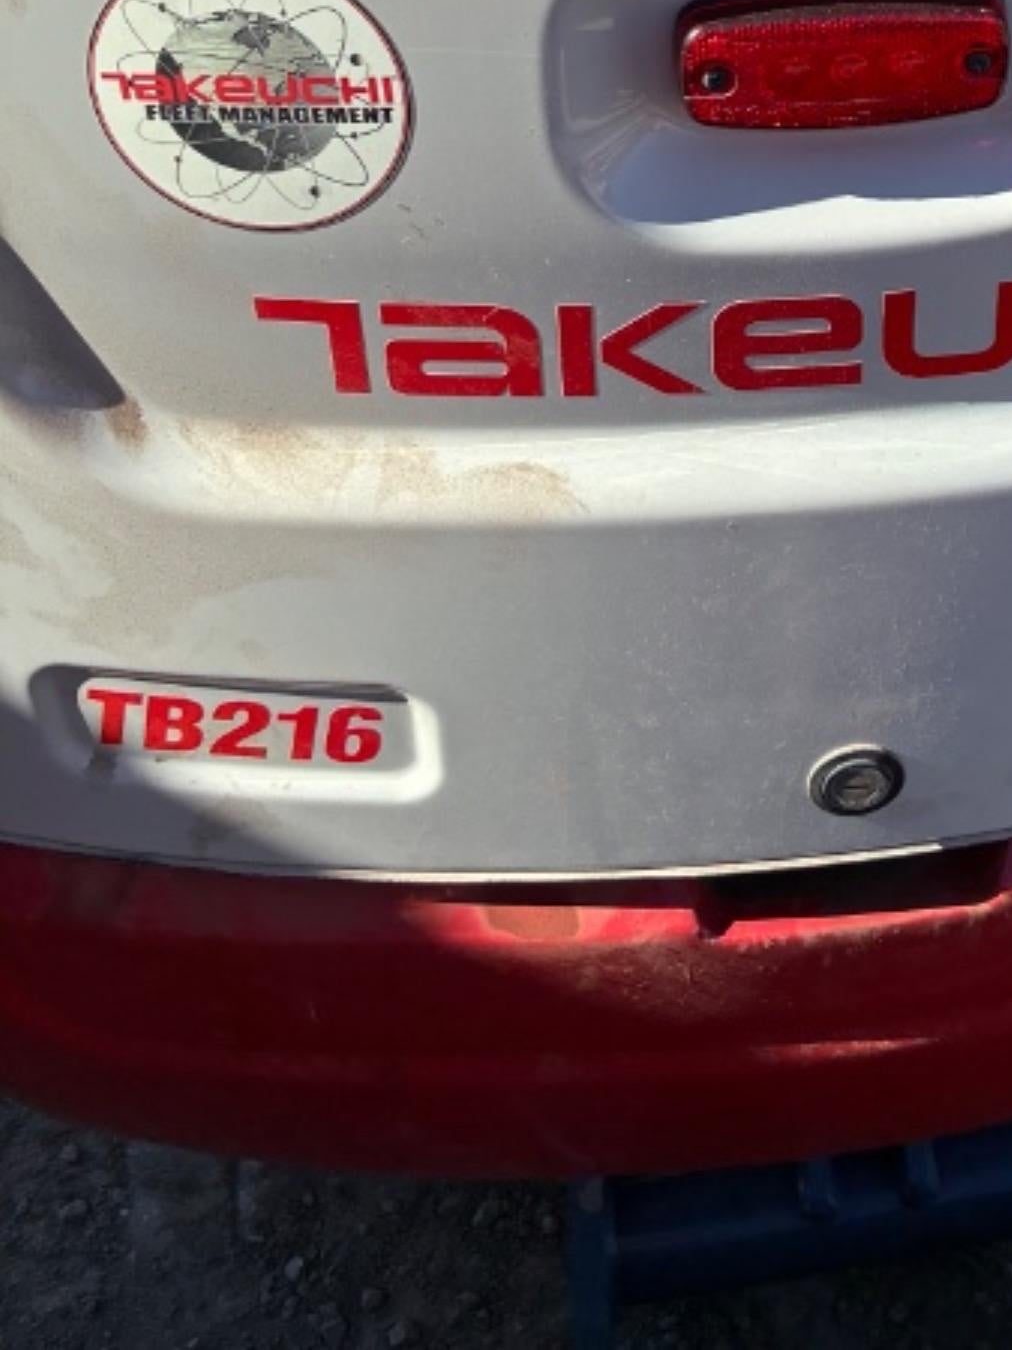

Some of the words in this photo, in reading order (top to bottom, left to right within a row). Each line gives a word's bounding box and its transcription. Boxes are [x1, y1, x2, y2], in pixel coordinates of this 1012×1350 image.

[146, 105, 211, 123] FLEET
[219, 107, 394, 124] MANAGEMENT
[86, 688, 384, 764] TB216
